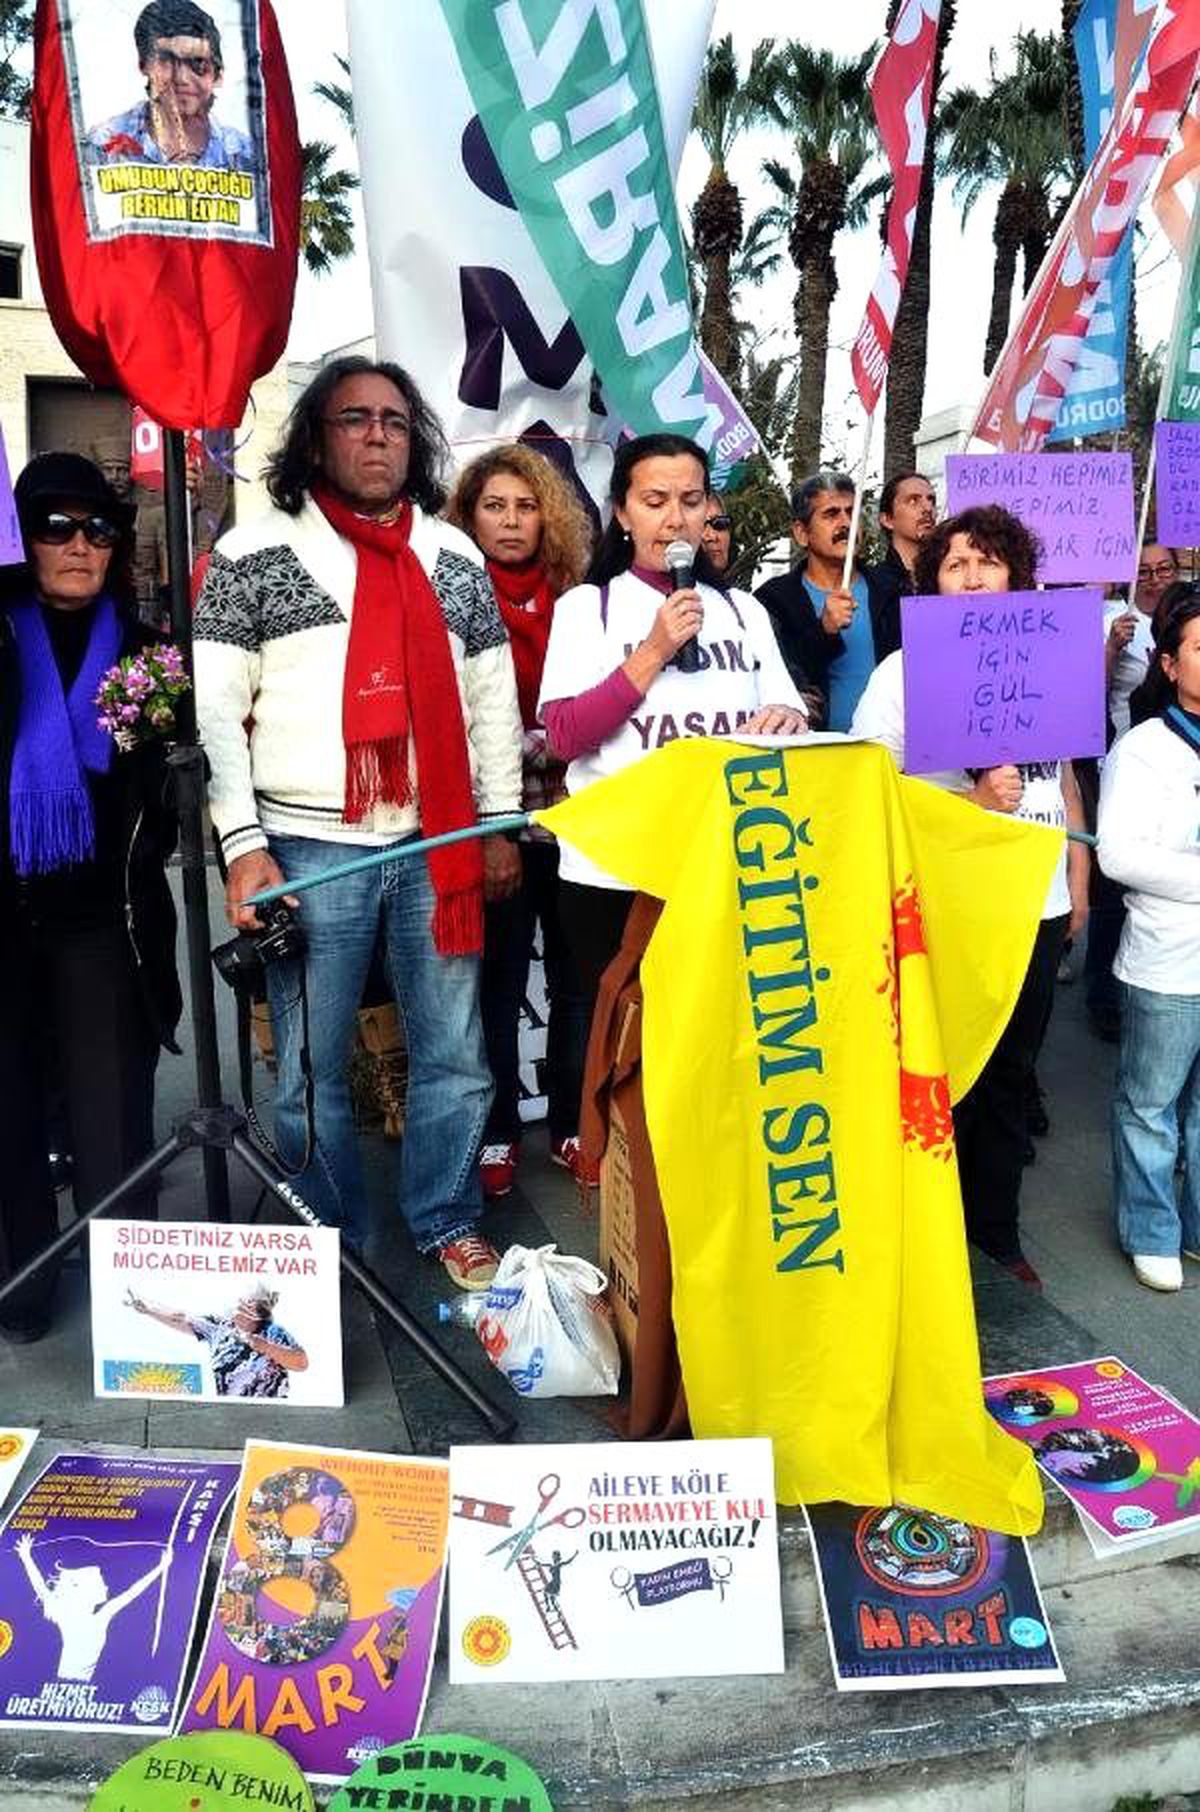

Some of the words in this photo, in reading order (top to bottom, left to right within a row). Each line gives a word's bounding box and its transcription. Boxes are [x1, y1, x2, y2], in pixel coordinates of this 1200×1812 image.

[98, 165, 179, 194] UMUDUN
[121, 193, 187, 219] BERKİN
[190, 197, 241, 226] ELVAN
[957, 460, 1038, 489] BİRİMİZ
[1051, 457, 1128, 486] HEPİMİZ
[1010, 494, 1100, 516] EPİMİZ
[959, 608, 1060, 639] EKMEK
[977, 641, 1031, 673] İÇİN
[973, 673, 1043, 707] GÜL
[967, 708, 1035, 737] İÇİN
[724, 749, 831, 1086] EĞİTİM
[763, 1102, 845, 1273] SEN
[117, 1225, 233, 1247] ŞİDDETİNİZ
[240, 1231, 313, 1251] VARSA
[113, 1248, 268, 1274] MÜCADELEMİZ
[274, 1257, 318, 1276] VAR
[588, 1472, 664, 1498] AİLEYE
[671, 1468, 732, 1495] KÖLE
[587, 1499, 719, 1525] SERMAYEYE
[726, 1498, 772, 1520] KUL
[589, 1518, 761, 1552] OLMAYACAĞIZ!
[859, 1591, 1006, 1649] MART
[196, 1620, 395, 1737] MART
[144, 1757, 227, 1791] BEDEN
[377, 1743, 507, 1782] DÜNYA
